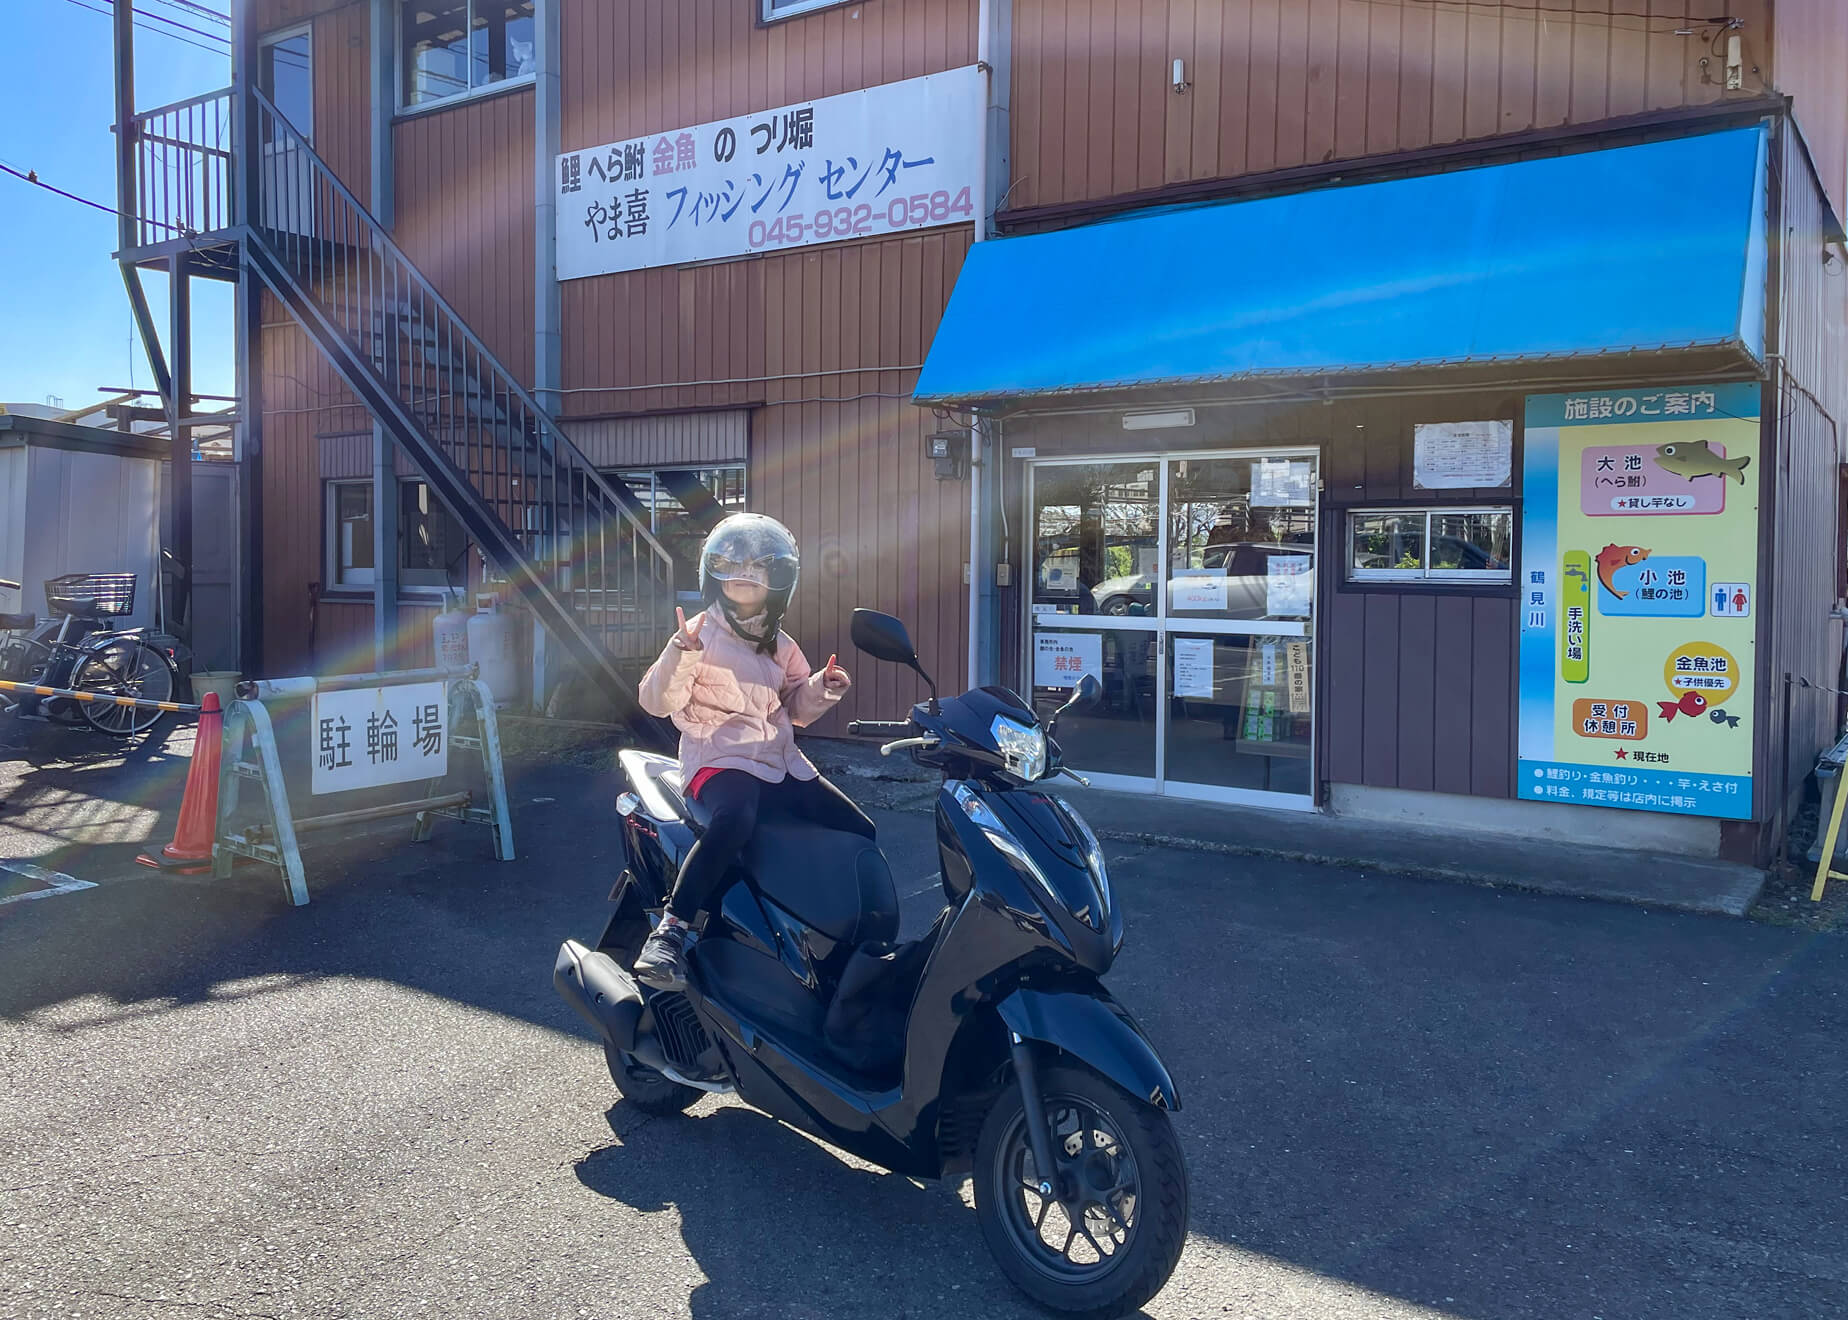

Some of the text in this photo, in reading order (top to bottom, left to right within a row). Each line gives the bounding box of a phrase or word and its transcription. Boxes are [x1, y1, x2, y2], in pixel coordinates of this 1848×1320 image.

[561, 107, 814, 195] 鯉 へら鮒 金魚 の つり堀
[584, 146, 935, 243] やま喜 フィッシング センター
[748, 186, 974, 249] 045-932-0584
[1564, 391, 1715, 420] 施設のご案内
[1529, 571, 1545, 628] 鶴見川
[1567, 607, 1583, 660] 手洗い場
[1055, 656, 1082, 672] 禁煙
[1676, 656, 1727, 672] 金魚池
[1683, 677, 1724, 689] 子供優先
[319, 704, 442, 771] 駐輪場
[1584, 719, 1636, 736] 休憩所
[1633, 750, 1669, 764] 現在地
